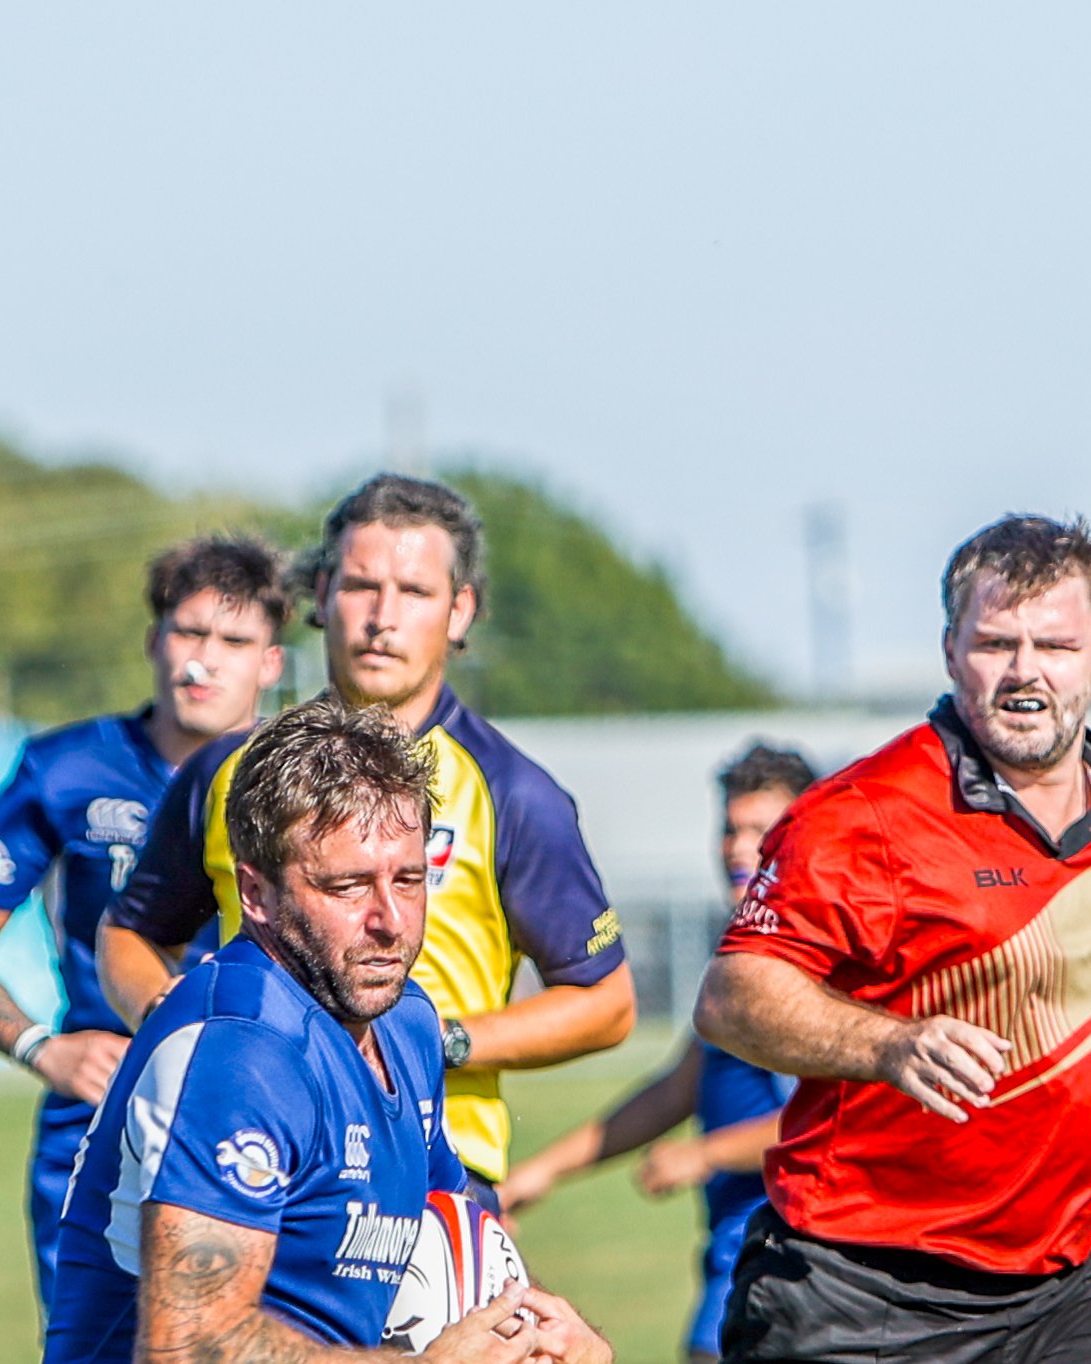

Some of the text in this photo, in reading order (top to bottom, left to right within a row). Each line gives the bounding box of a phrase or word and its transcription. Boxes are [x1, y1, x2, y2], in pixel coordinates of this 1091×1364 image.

[973, 867, 1029, 888] BLK
[334, 1200, 420, 1266] Tullamore
[331, 1262, 373, 1281] Irish
